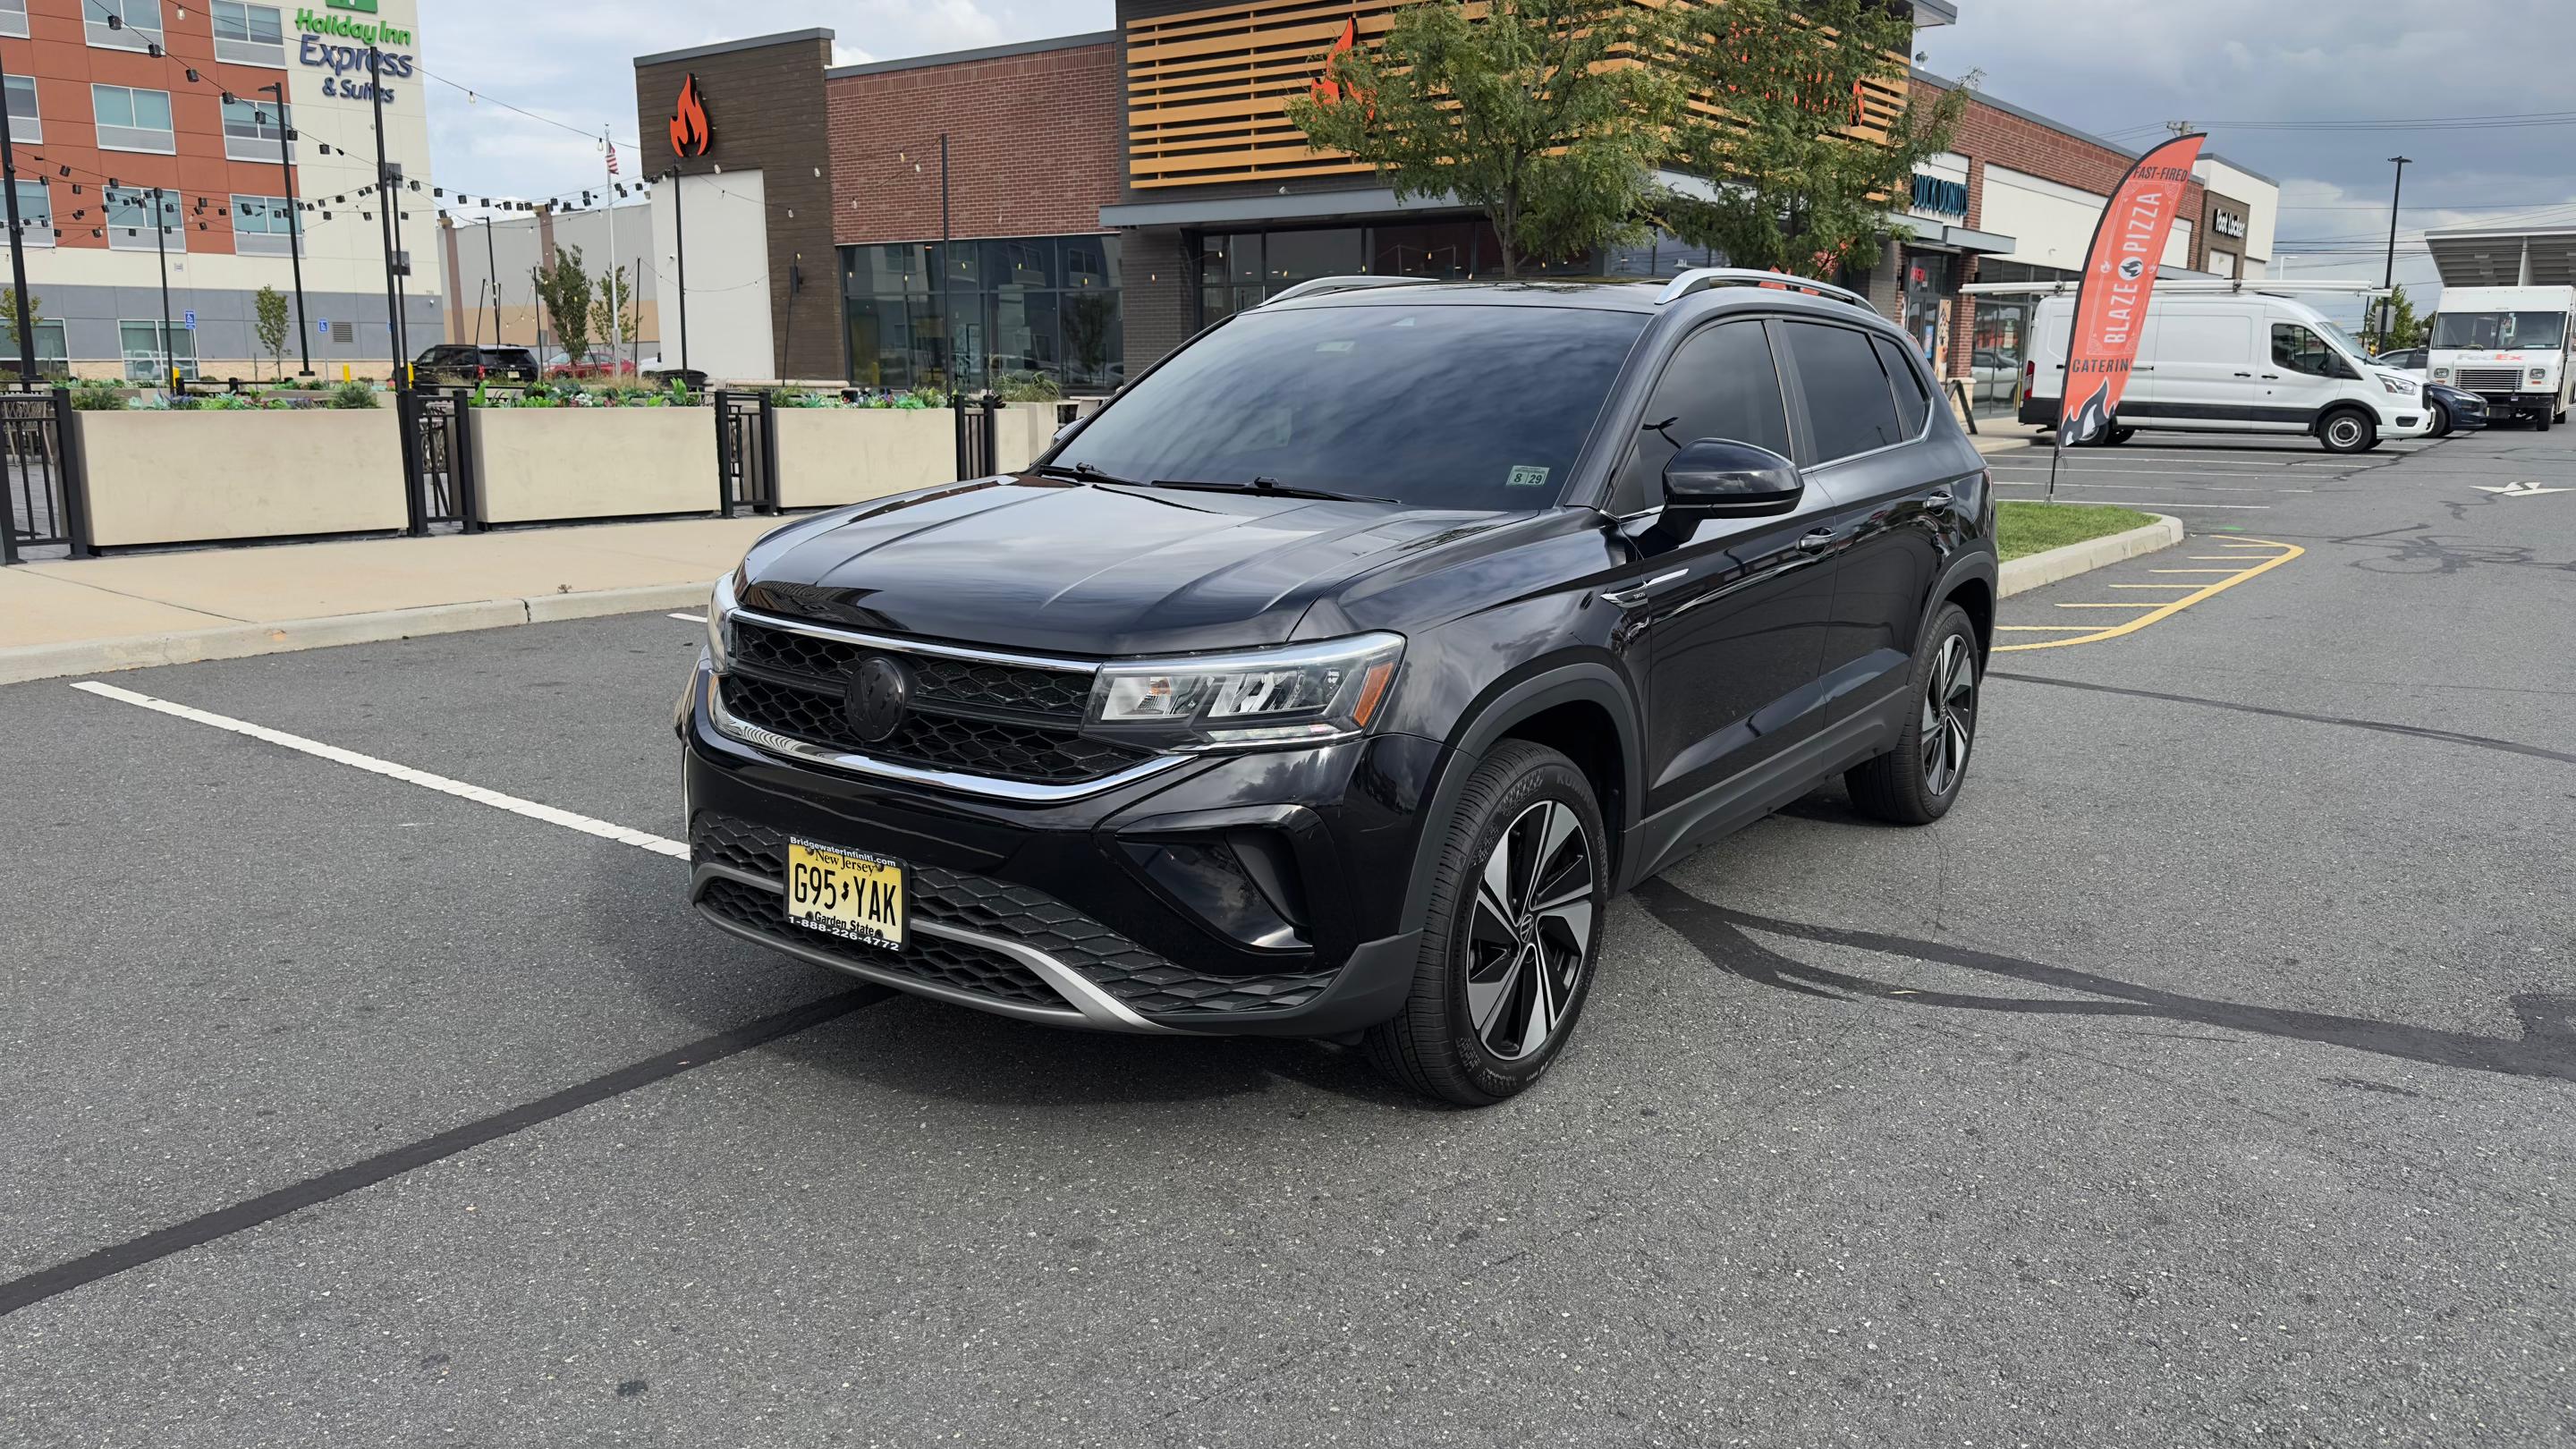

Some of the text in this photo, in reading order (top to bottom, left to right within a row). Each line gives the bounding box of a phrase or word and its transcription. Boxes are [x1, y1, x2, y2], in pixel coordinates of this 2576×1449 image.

[295, 8, 411, 46] Holiday Inn
[300, 34, 412, 78] Express
[322, 77, 336, 96] &
[2132, 166, 2188, 182] FAST-FIRED
[1914, 173, 1968, 216] DUCK DONUTS
[2215, 208, 2245, 238] Foot Locker
[2104, 192, 2162, 343] BLAZE PIZZA
[2072, 358, 2133, 372] CATERIN
[1513, 473, 1543, 484] 8 29
[790, 836, 896, 867] BridgewaterInfiniti.com
[815, 849, 876, 877] New Jersey
[794, 863, 896, 927] G95 YAK
[789, 916, 899, 951] 1-888-226-4772
[815, 911, 875, 936] Garden State
